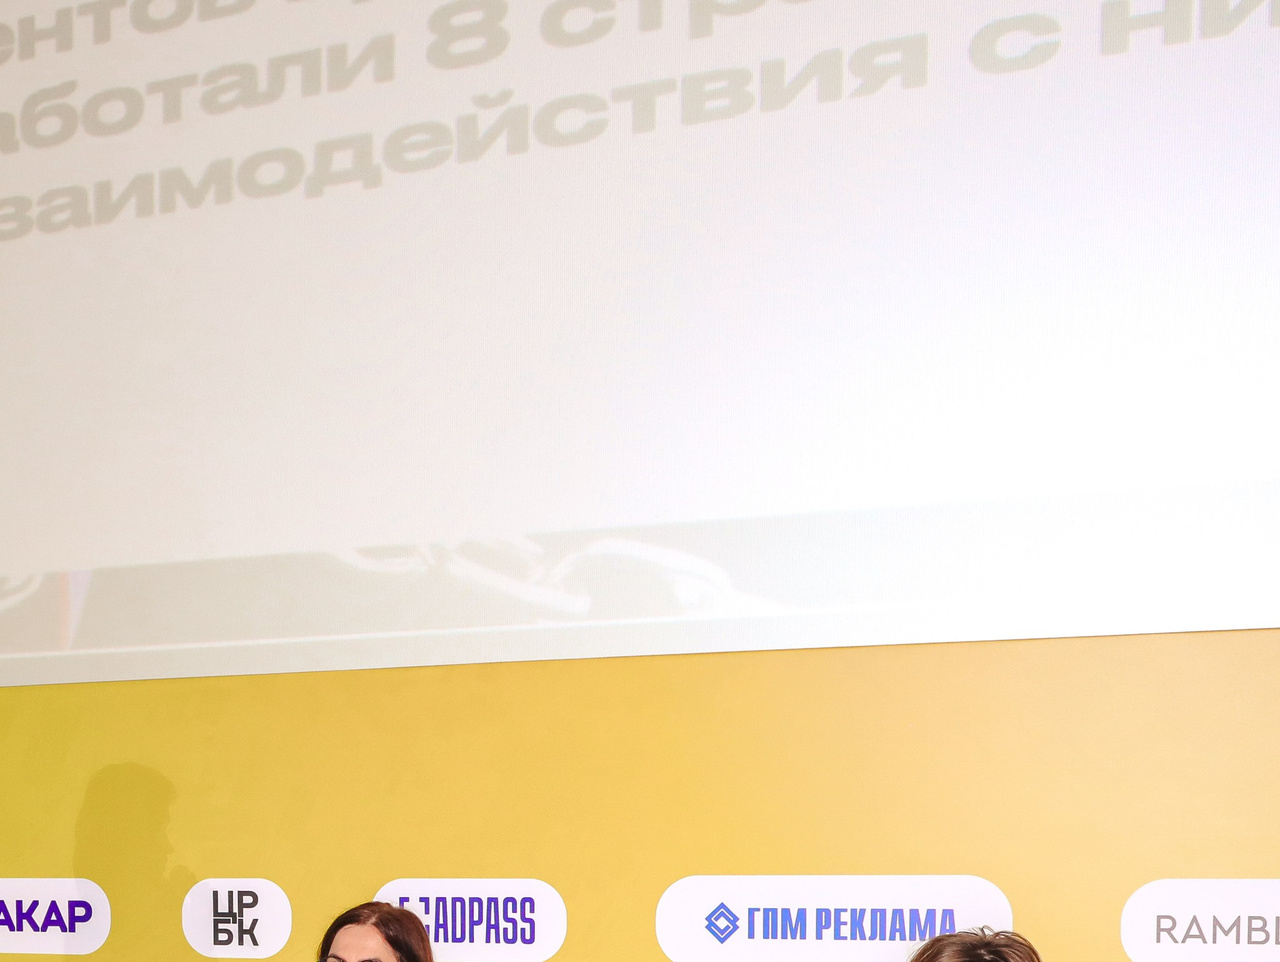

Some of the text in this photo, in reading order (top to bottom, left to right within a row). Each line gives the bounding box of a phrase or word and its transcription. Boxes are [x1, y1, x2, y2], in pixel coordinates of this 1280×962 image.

[426, 0, 511, 70] 8
[968, 13, 1062, 74] с
[212, 890, 259, 925] ЦР
[434, 896, 536, 945] ADPASS
[747, 907, 956, 941] ГПМ РЕКЛАМА
[213, 918, 260, 946] БК
